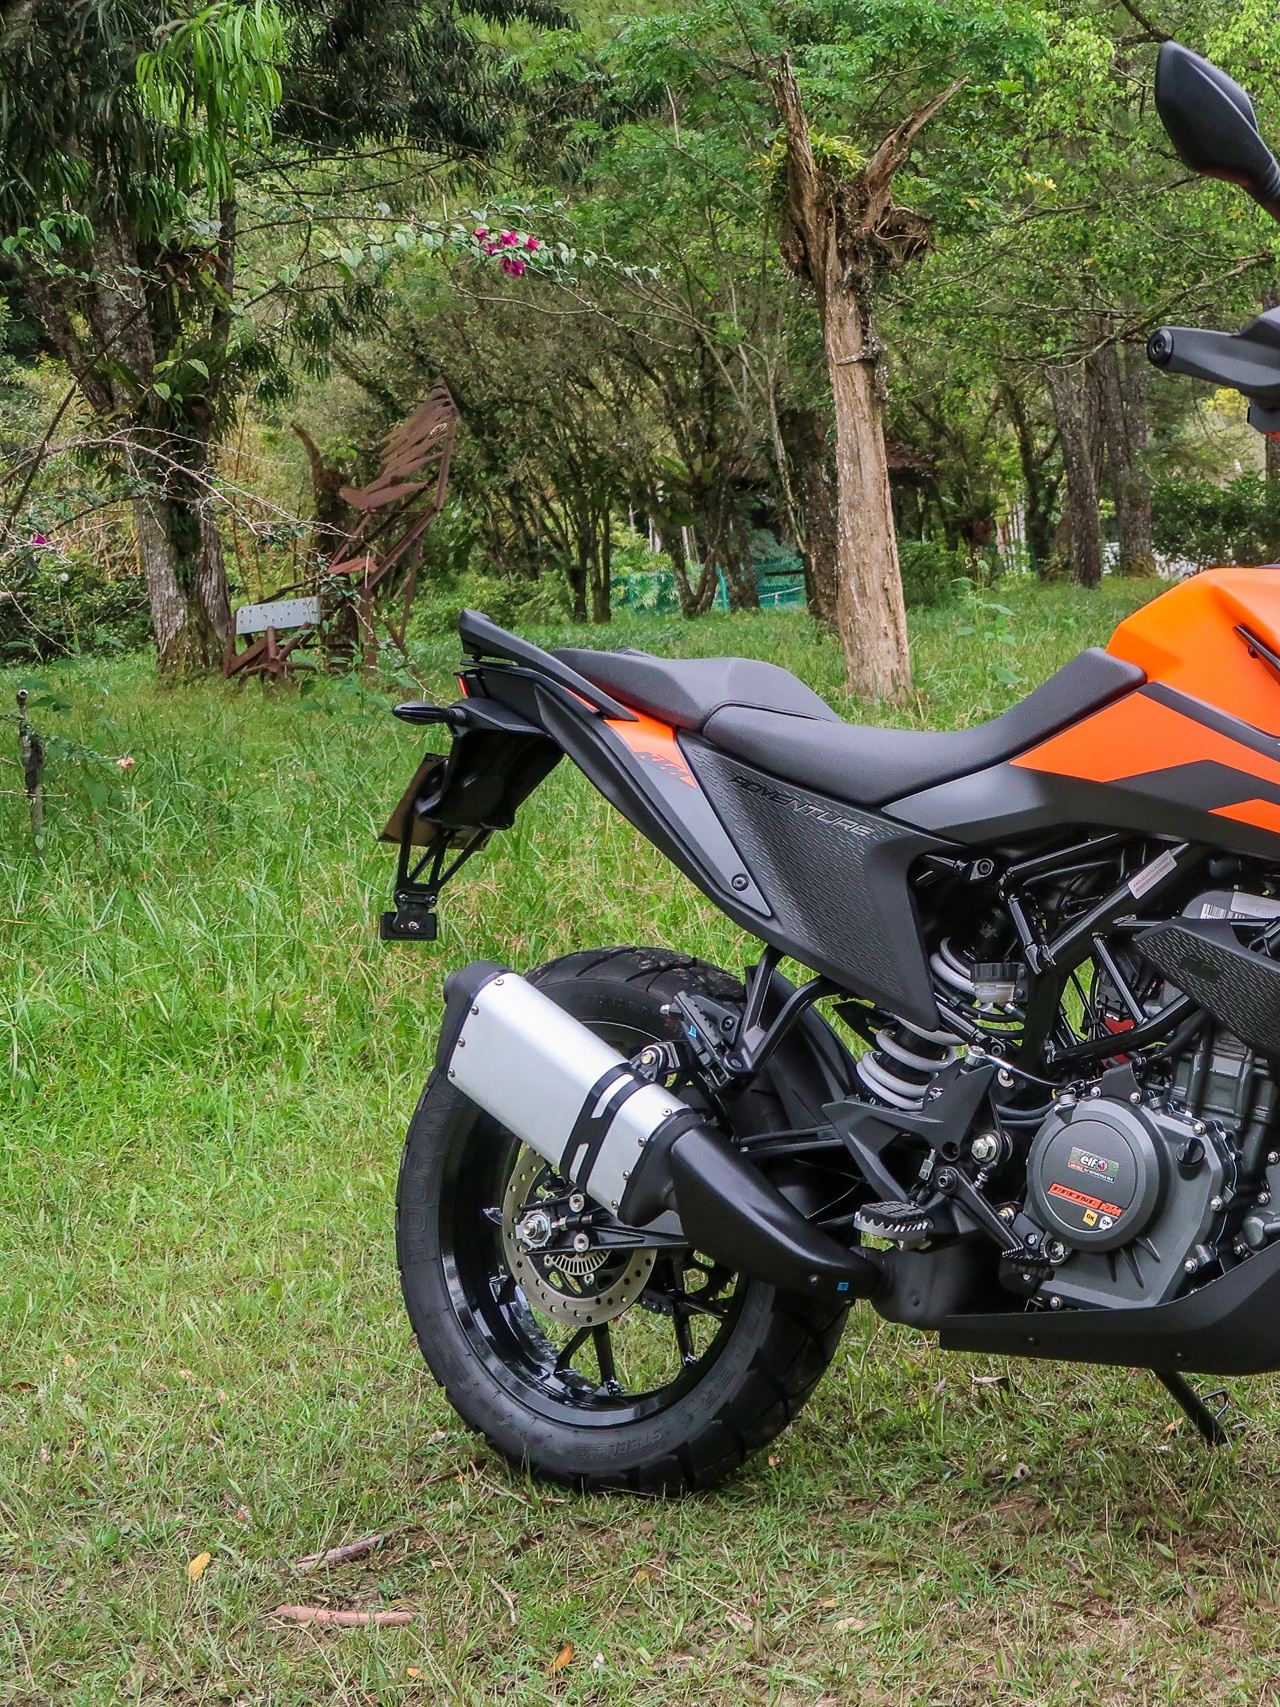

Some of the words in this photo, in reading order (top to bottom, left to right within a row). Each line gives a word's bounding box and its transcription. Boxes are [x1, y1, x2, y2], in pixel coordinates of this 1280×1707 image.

[729, 774, 878, 837] ADVENTURE
[1080, 1155, 1098, 1168] elf
[1086, 1213, 1095, 1221] OK
[1102, 1219, 1112, 1227] OK
